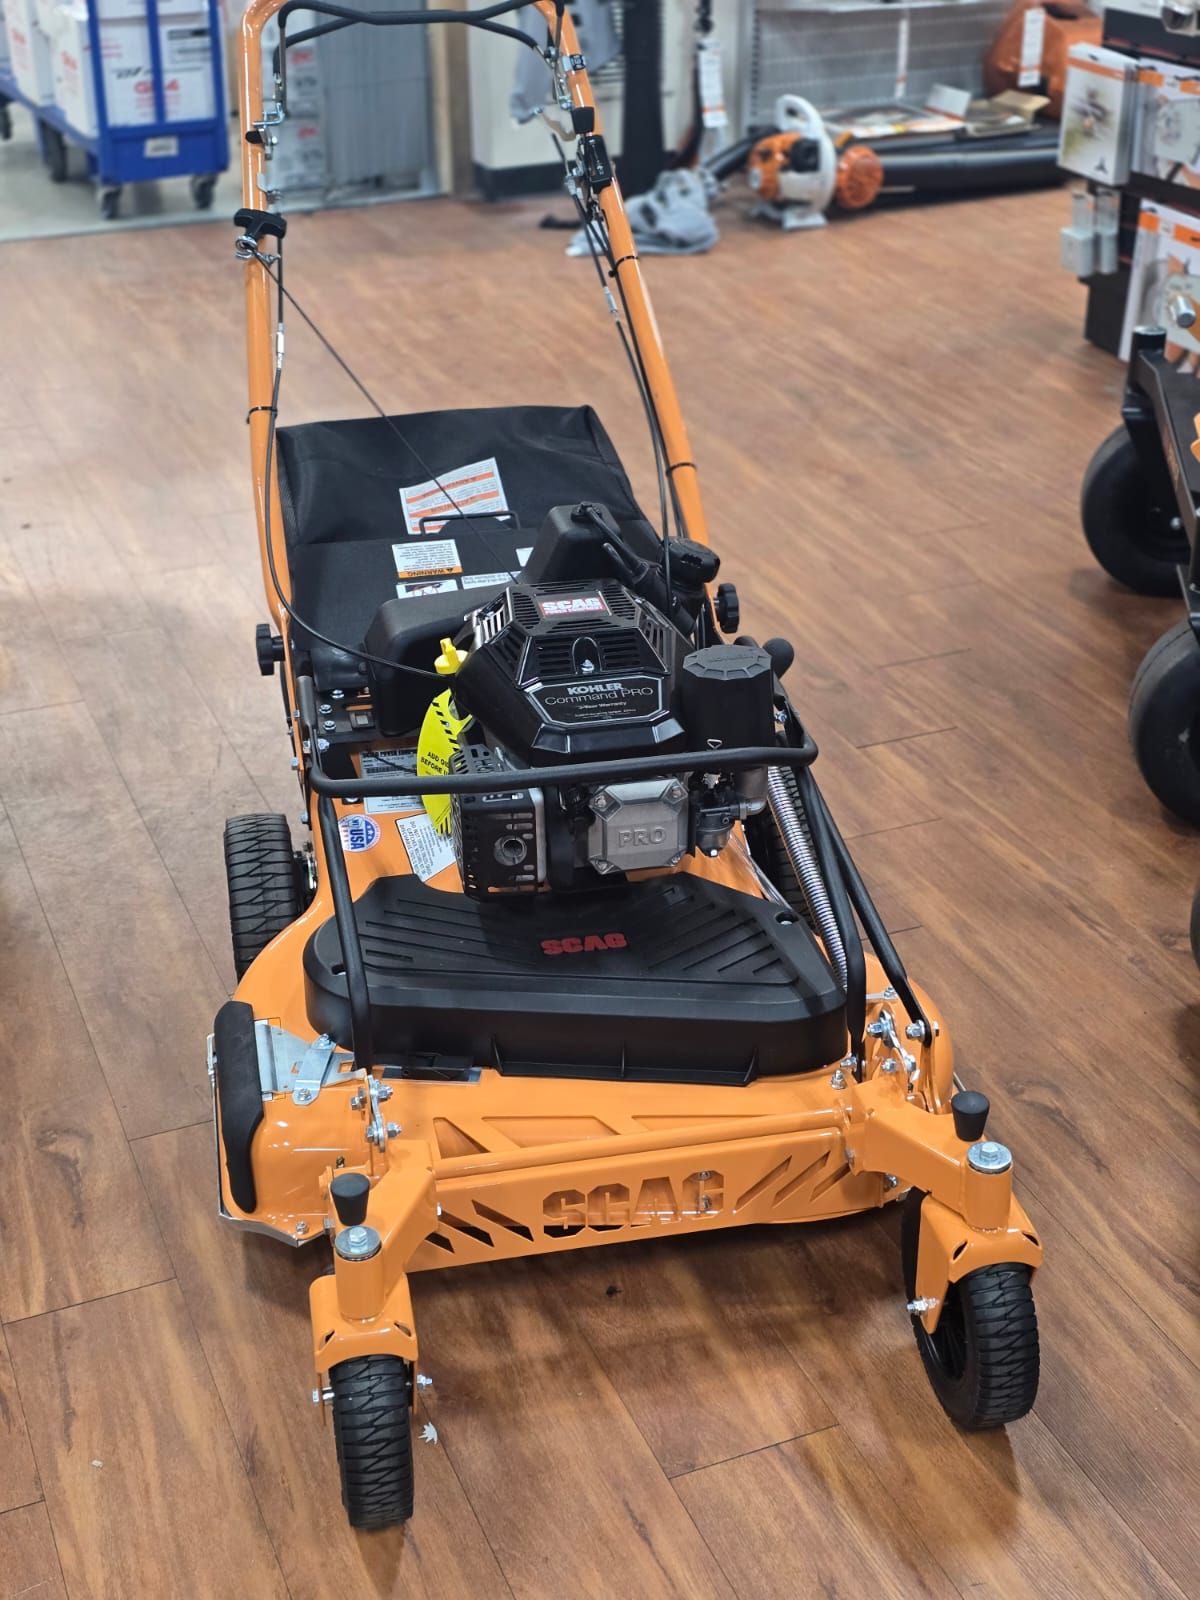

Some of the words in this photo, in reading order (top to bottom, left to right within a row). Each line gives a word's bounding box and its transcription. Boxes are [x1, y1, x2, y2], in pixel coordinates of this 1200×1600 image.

[407, 568, 445, 577] WARNING
[542, 597, 601, 611] SCAG
[545, 690, 618, 705] Command
[621, 687, 654, 698] PRO
[567, 682, 624, 695] KOHLER
[420, 756, 442, 774] BEFORE
[427, 751, 440, 762] ADD
[350, 829, 365, 850] USA
[618, 826, 666, 848] PRO
[541, 933, 627, 955] SCAG
[543, 1170, 724, 1239] SCAG
